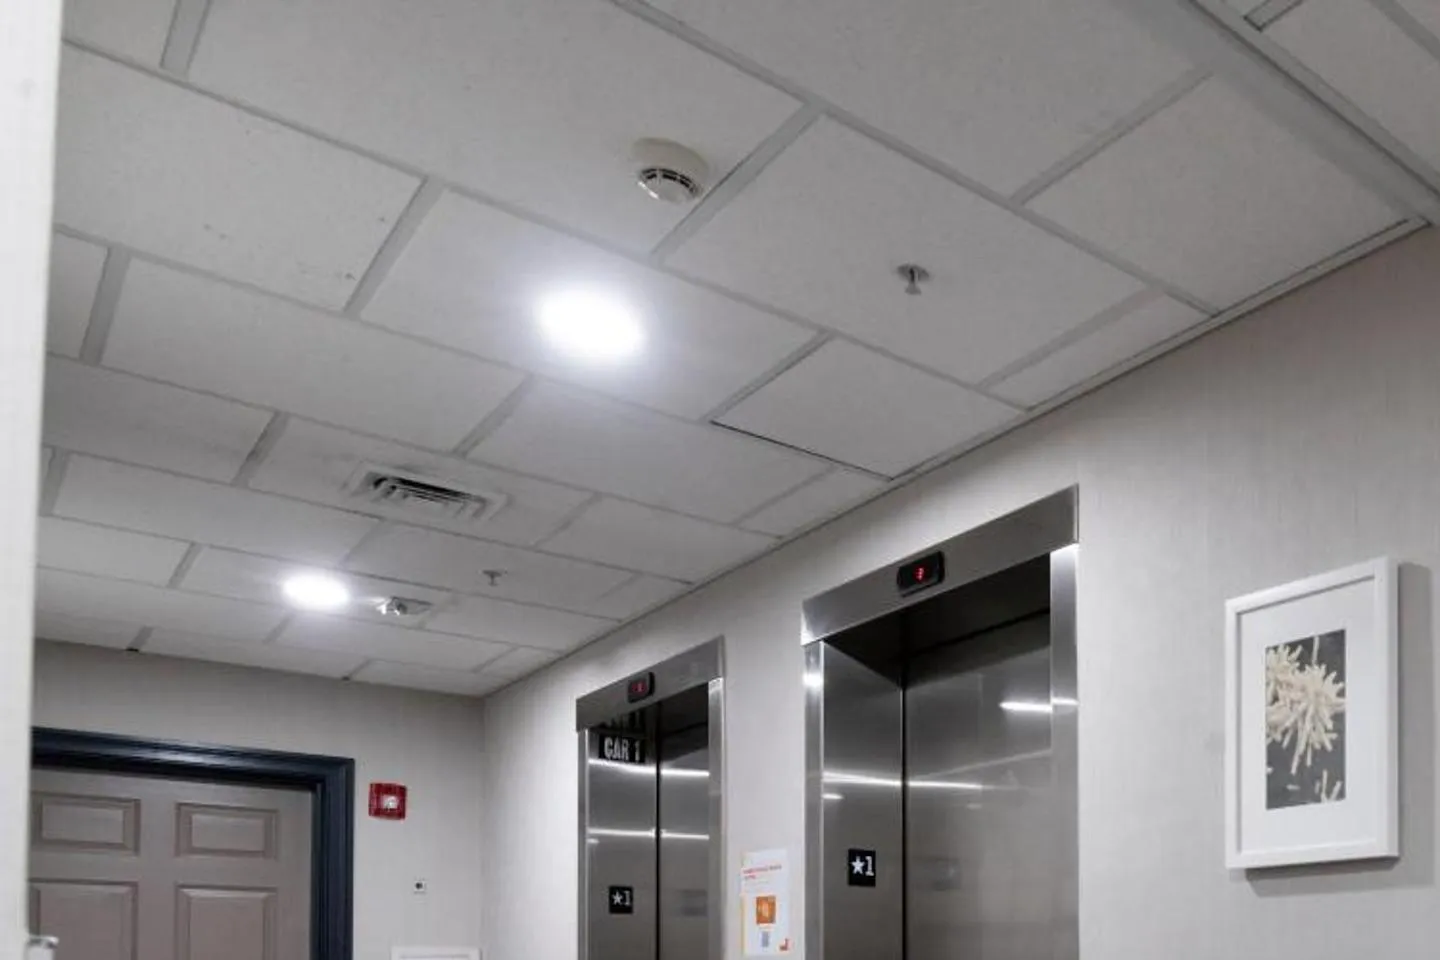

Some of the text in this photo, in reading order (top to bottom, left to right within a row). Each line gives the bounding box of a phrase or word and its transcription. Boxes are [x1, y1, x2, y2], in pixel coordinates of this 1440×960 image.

[604, 737, 641, 762] CAR 1
[865, 855, 875, 877] 1
